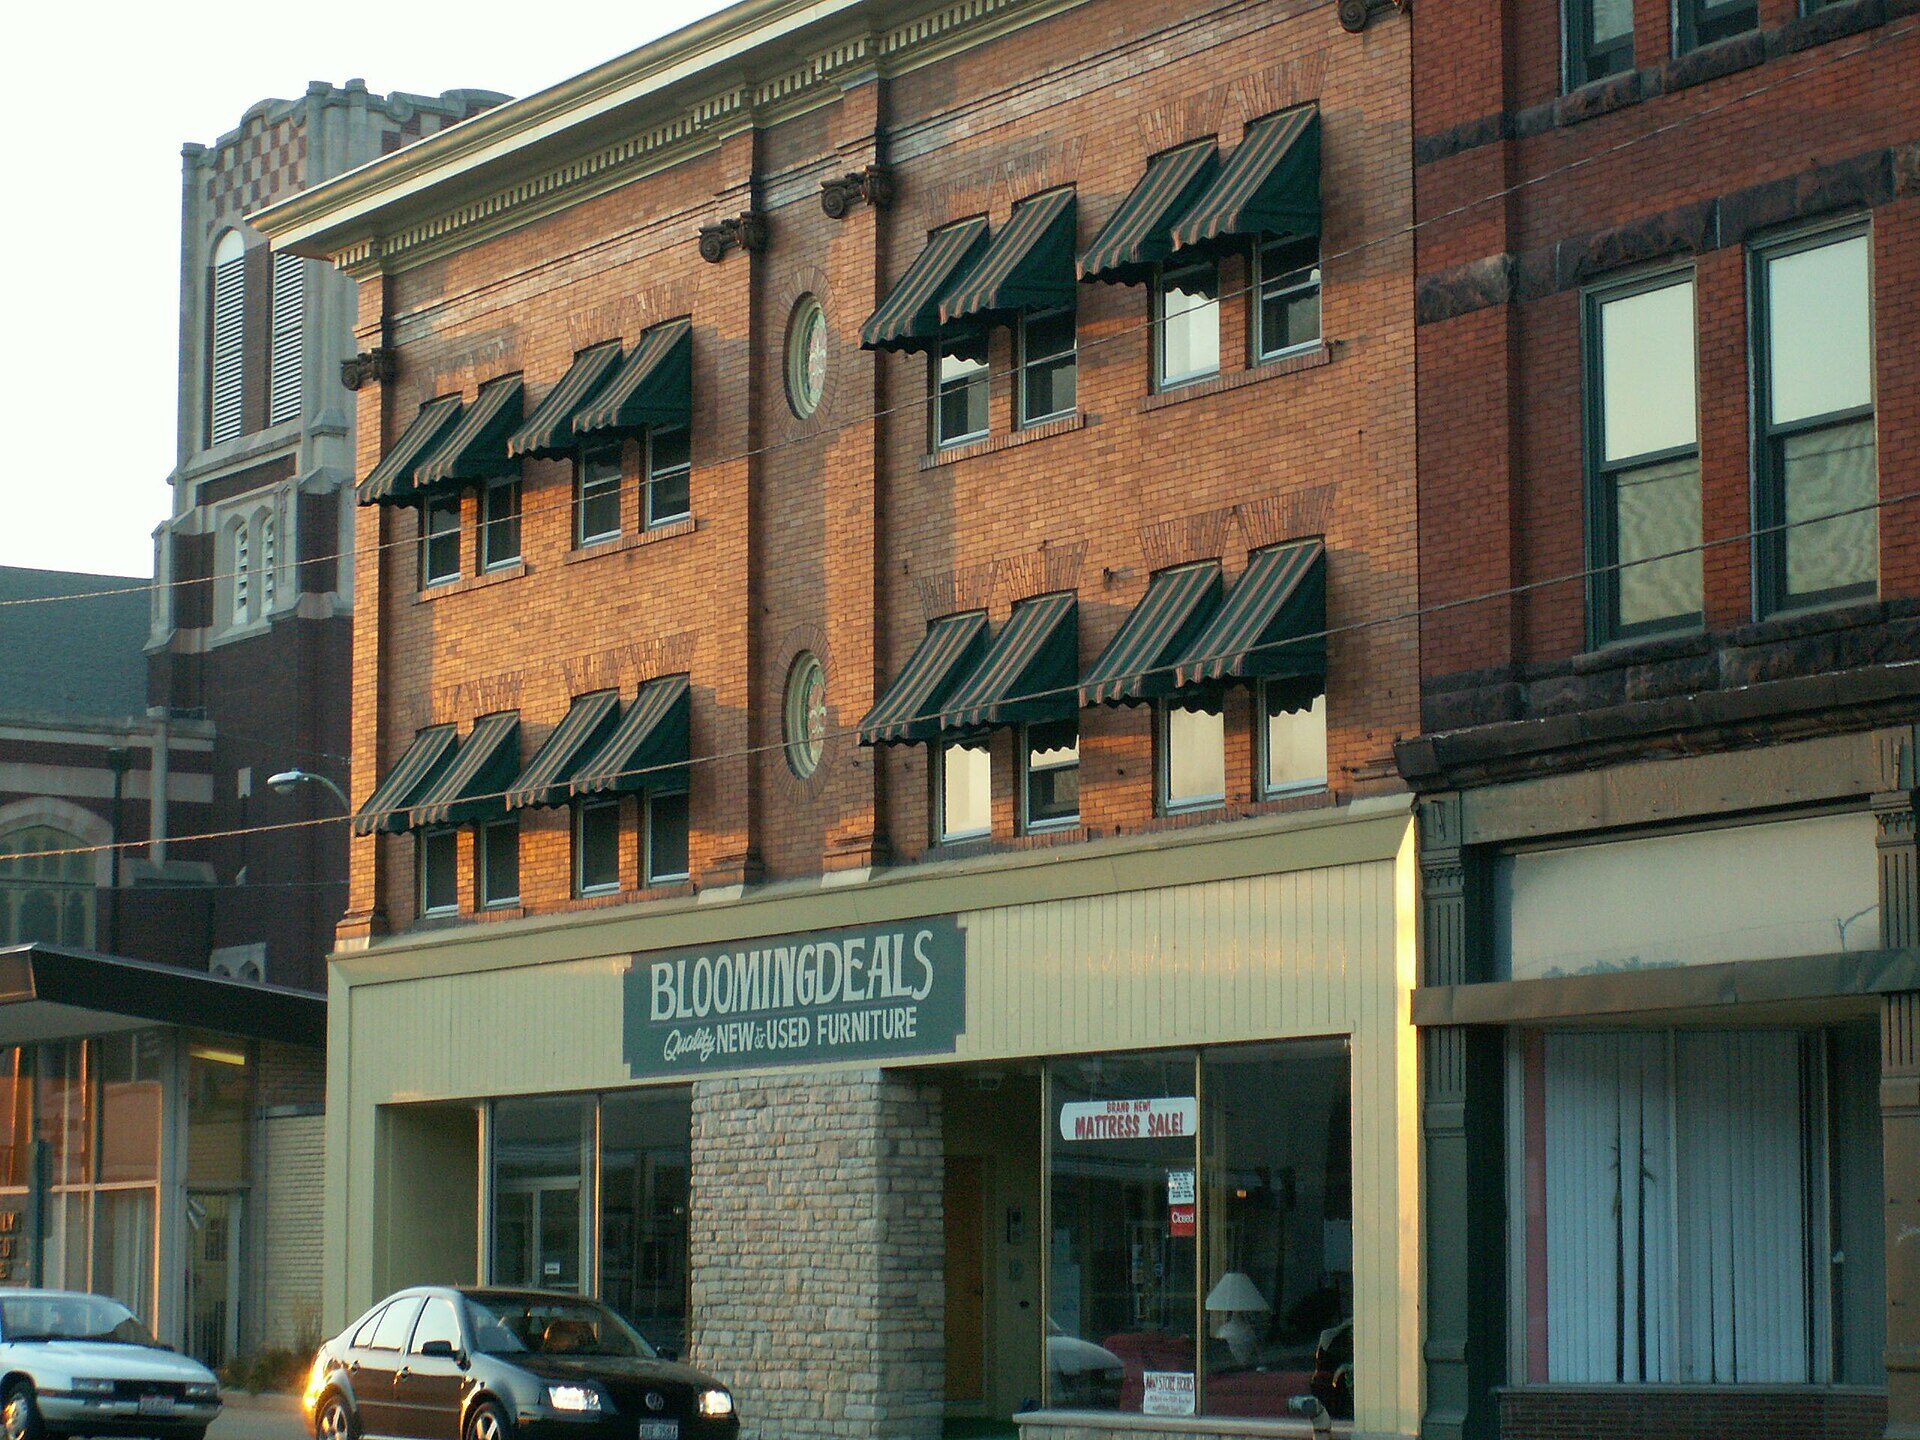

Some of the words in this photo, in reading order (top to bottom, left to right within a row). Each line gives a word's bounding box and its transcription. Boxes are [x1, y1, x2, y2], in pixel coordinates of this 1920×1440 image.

[650, 930, 934, 1021] BLOOMINGDEALS
[664, 1028, 715, 1062] Quality
[716, 1022, 755, 1054] NEW
[754, 1027, 766, 1049] &
[767, 1017, 810, 1050] USED
[817, 1006, 917, 1045] FURNITURE
[1075, 1114, 1140, 1139] MATTRESS
[1148, 1112, 1184, 1136] SALE!
[1107, 1101, 1130, 1113] BRAND
